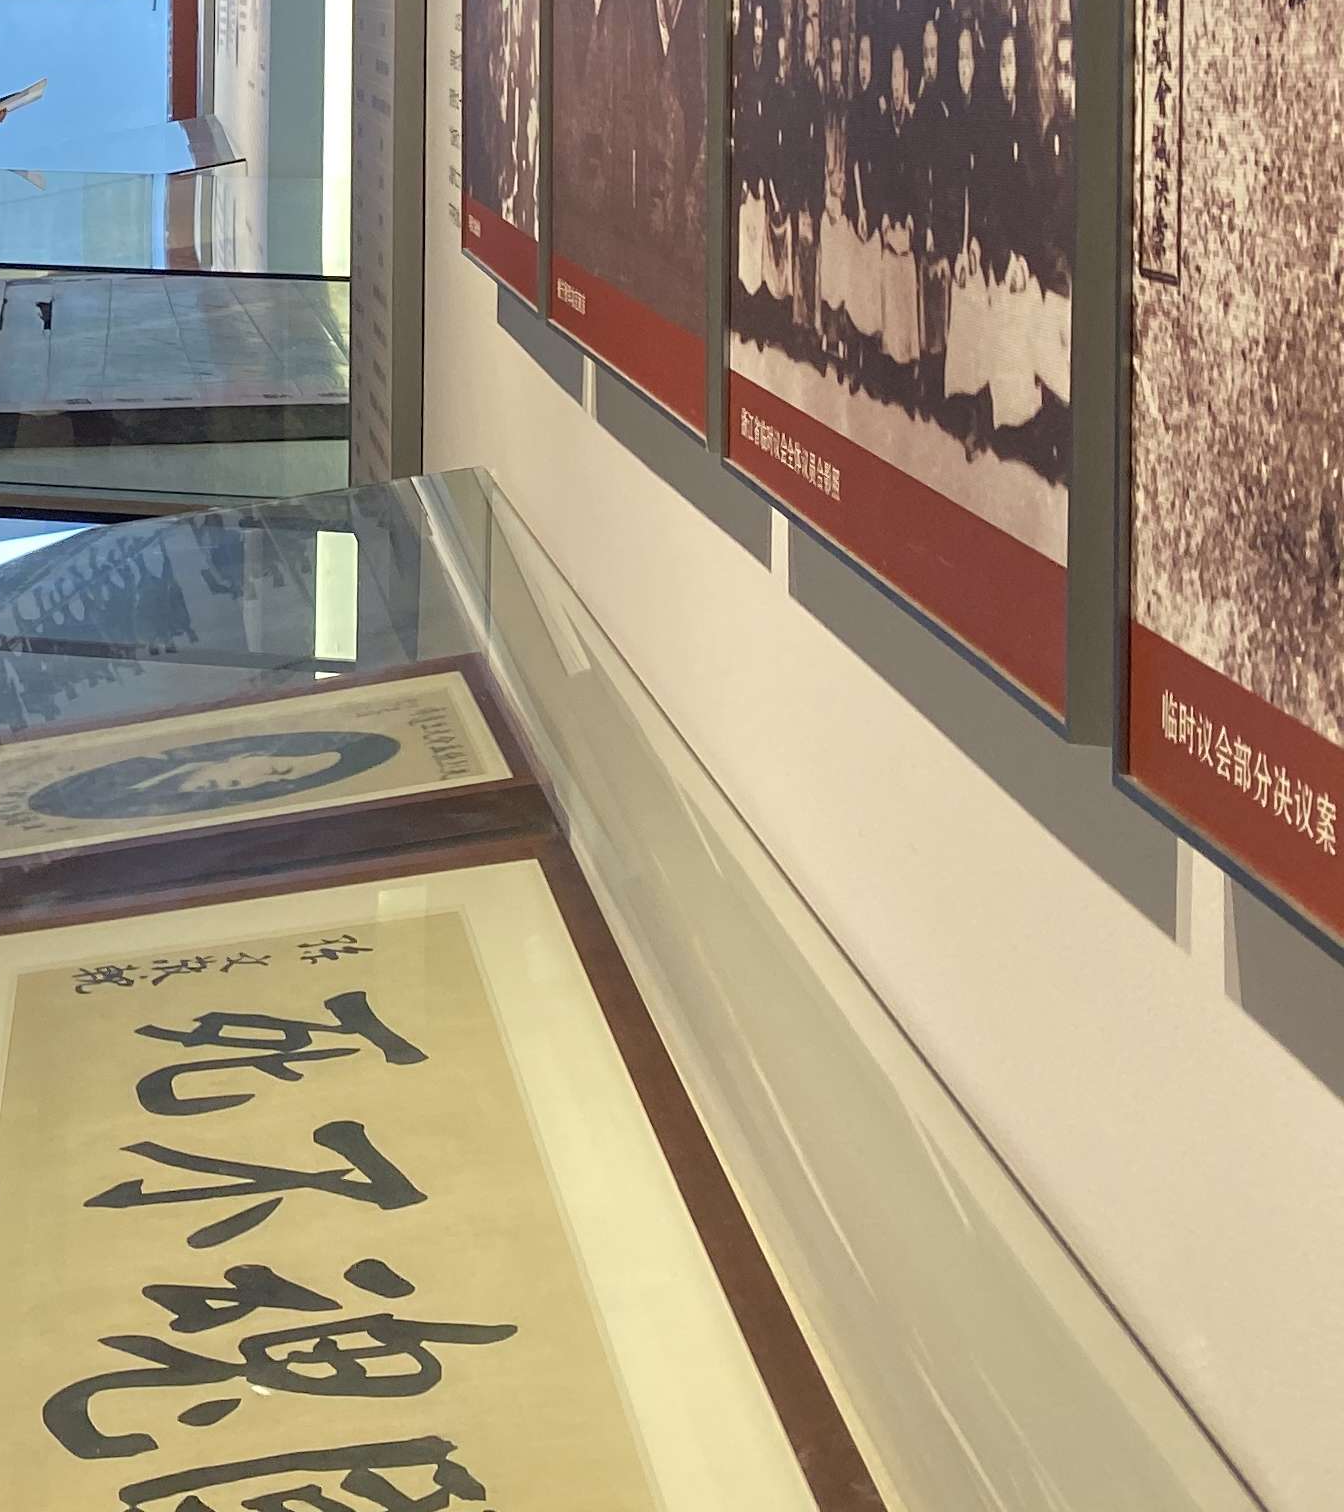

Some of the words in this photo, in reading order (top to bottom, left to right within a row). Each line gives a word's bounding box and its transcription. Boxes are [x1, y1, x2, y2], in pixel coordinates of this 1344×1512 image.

[1162, 688, 1337, 856] 临时议会部分决议案
